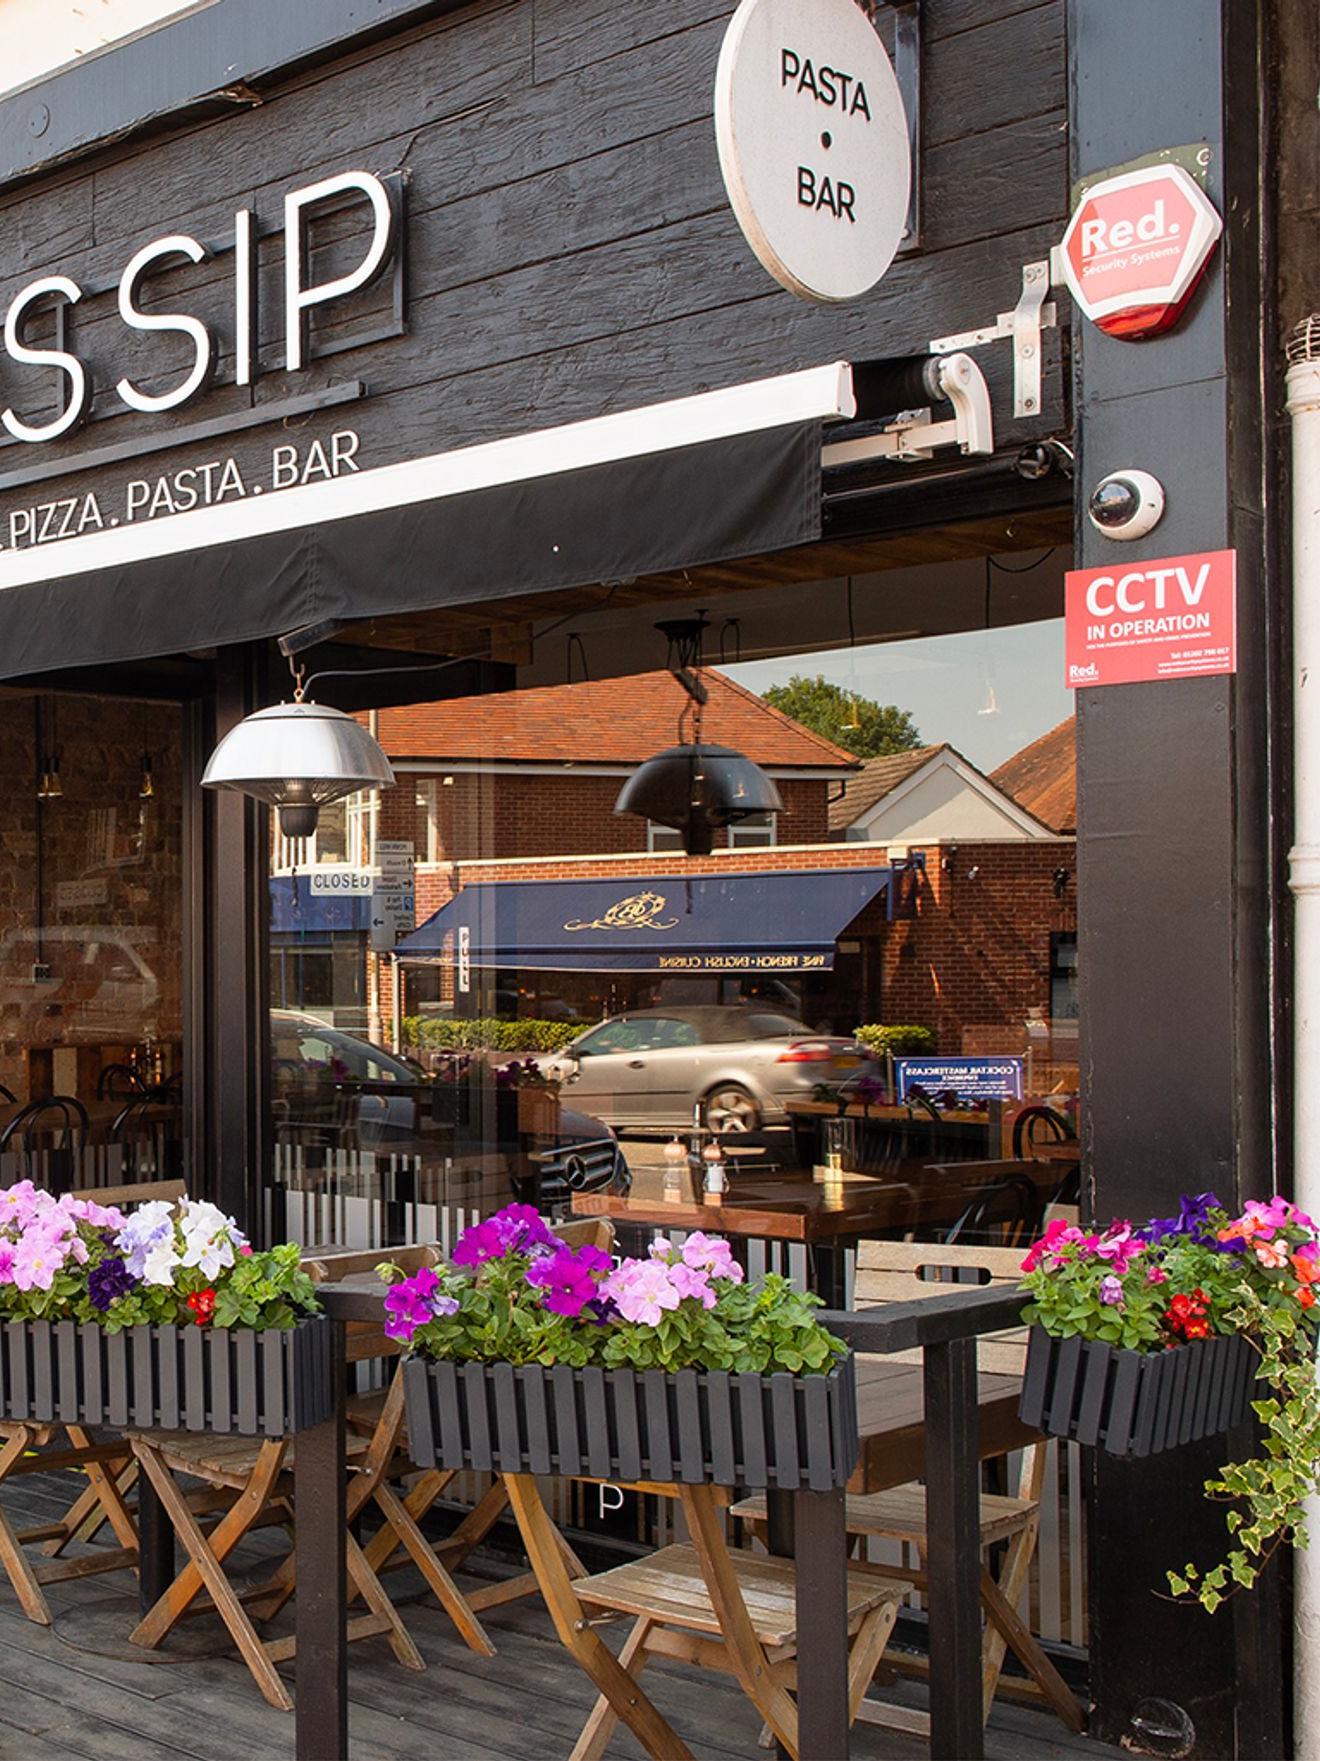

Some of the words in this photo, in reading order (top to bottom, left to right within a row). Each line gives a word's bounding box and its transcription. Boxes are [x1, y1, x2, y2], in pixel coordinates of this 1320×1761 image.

[781, 48, 871, 121] PASTA
[797, 166, 855, 223] BAR
[1081, 200, 1180, 256] Red.
[1082, 256, 1128, 277] Security
[1130, 246, 1180, 264] Systems
[272, 429, 361, 488] BAR
[1086, 563, 1211, 617] CCTV
[1087, 624, 1105, 641] IN
[1109, 612, 1210, 638] OPERATION
[313, 873, 370, 888] CLOSED
[599, 1483, 625, 1520] P
